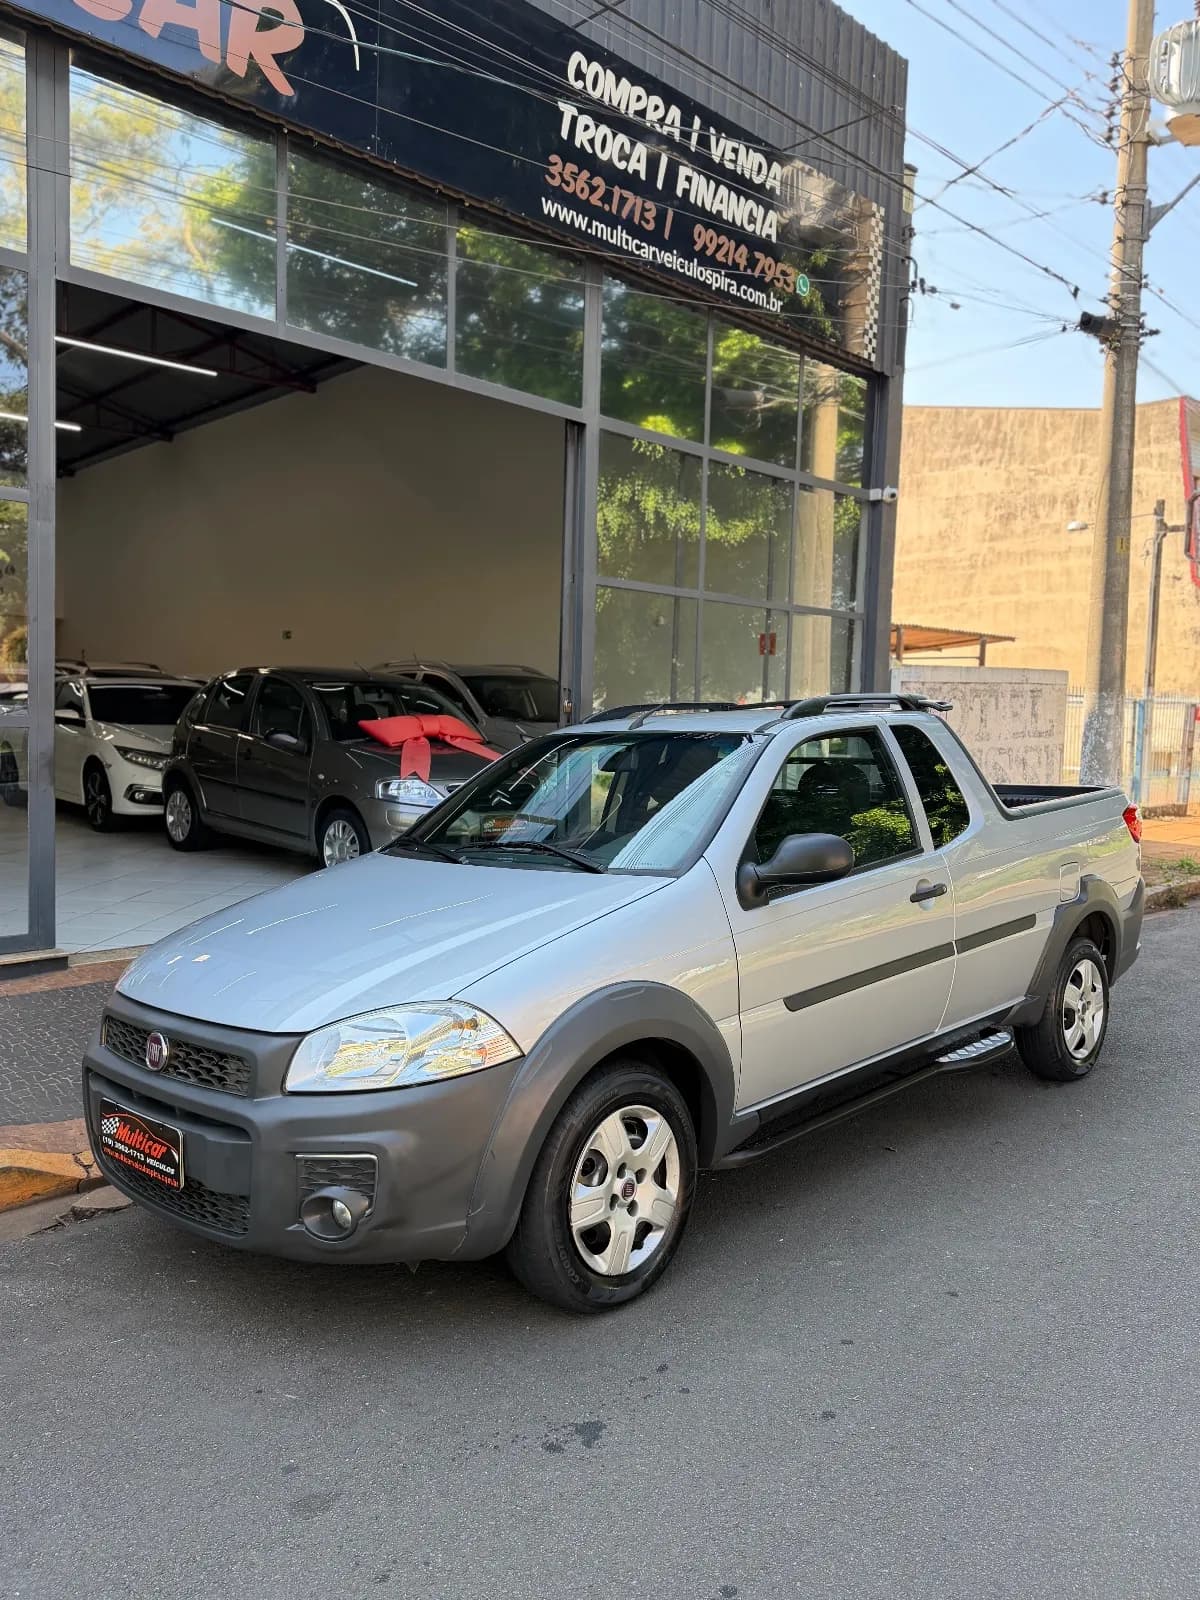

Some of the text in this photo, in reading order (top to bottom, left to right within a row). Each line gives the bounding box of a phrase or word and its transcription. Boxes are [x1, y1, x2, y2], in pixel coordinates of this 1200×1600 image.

[557, 101, 648, 181] TROCA
[676, 165, 778, 243] FINANCIA
[567, 51, 682, 142] COMPRA
[709, 126, 783, 195] VENDA
[544, 154, 657, 231] 3562.1713
[541, 197, 784, 313] www.multicarveiculospira.com.br
[115, 1121, 167, 1159] Multicar
